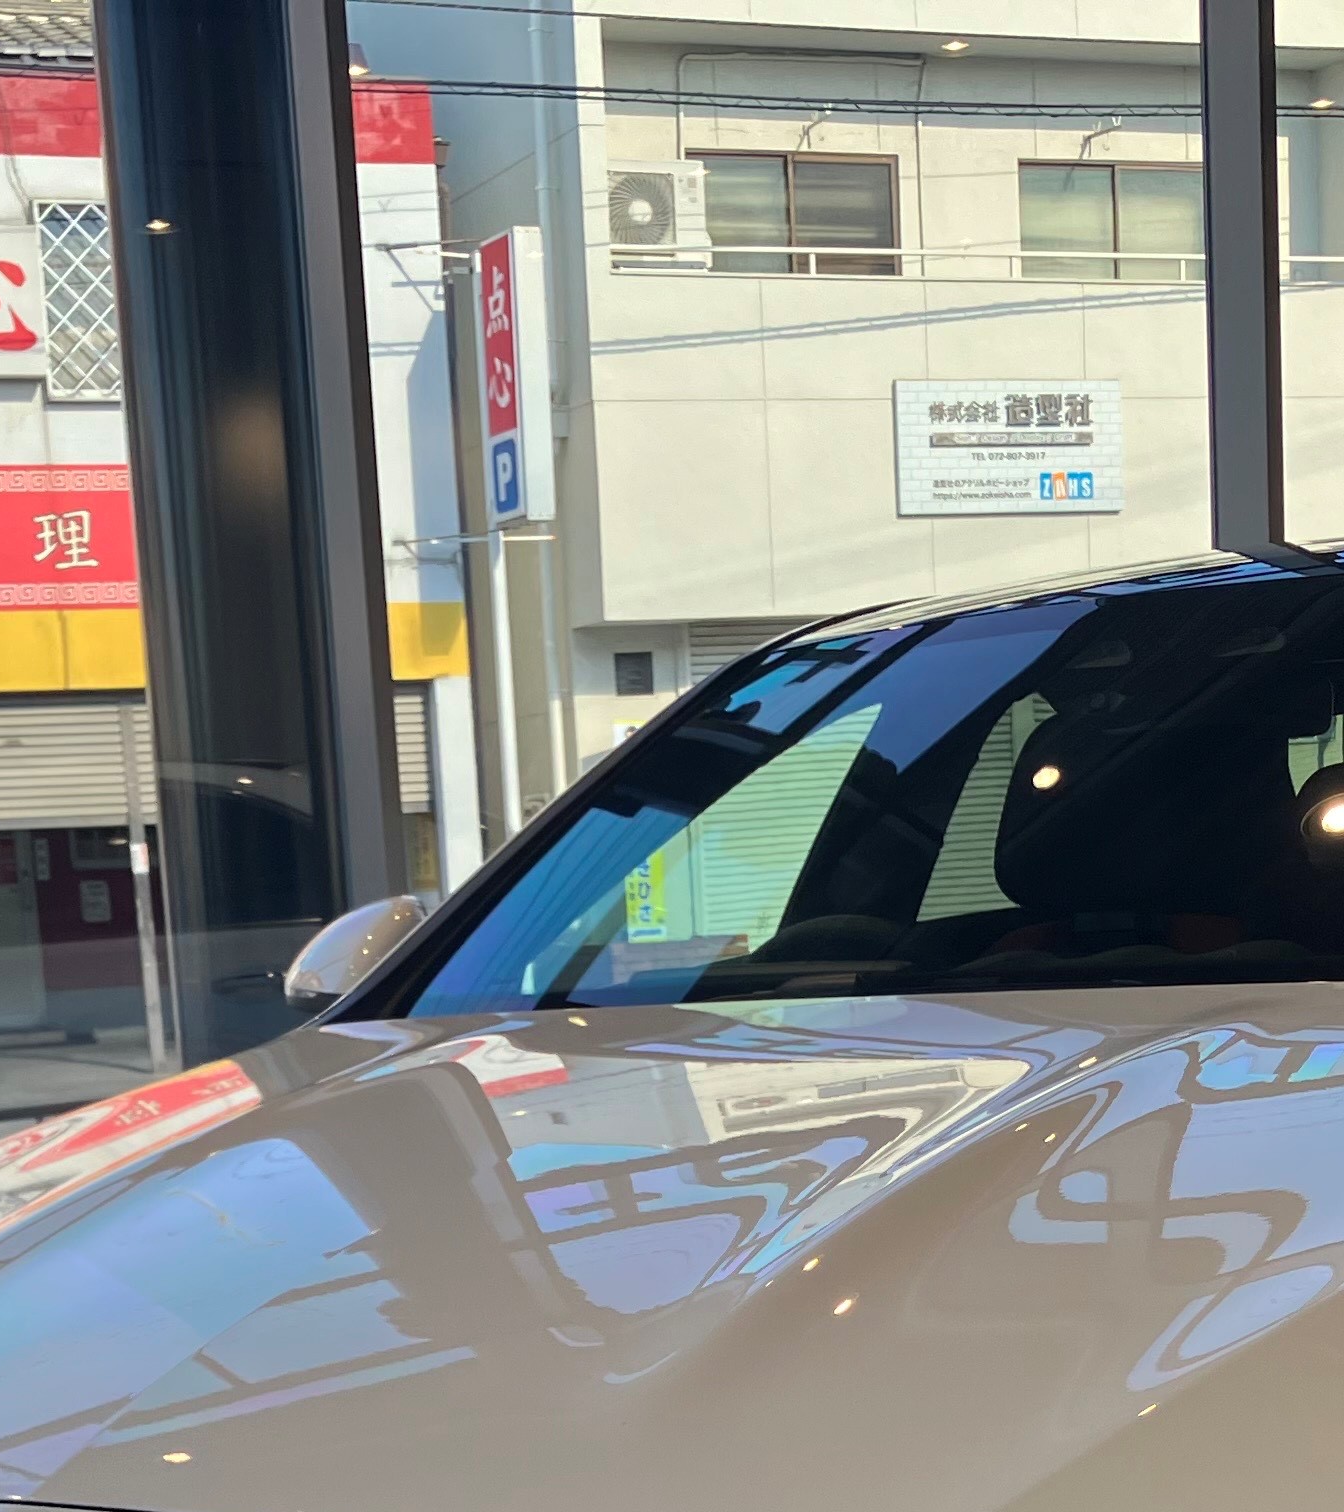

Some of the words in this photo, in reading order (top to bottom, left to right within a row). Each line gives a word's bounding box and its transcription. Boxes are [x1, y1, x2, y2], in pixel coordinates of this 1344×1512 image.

[486, 265, 514, 409] 点心
[928, 400, 1000, 424] 株式会社
[971, 452, 986, 461] TEL
[496, 451, 513, 503] P
